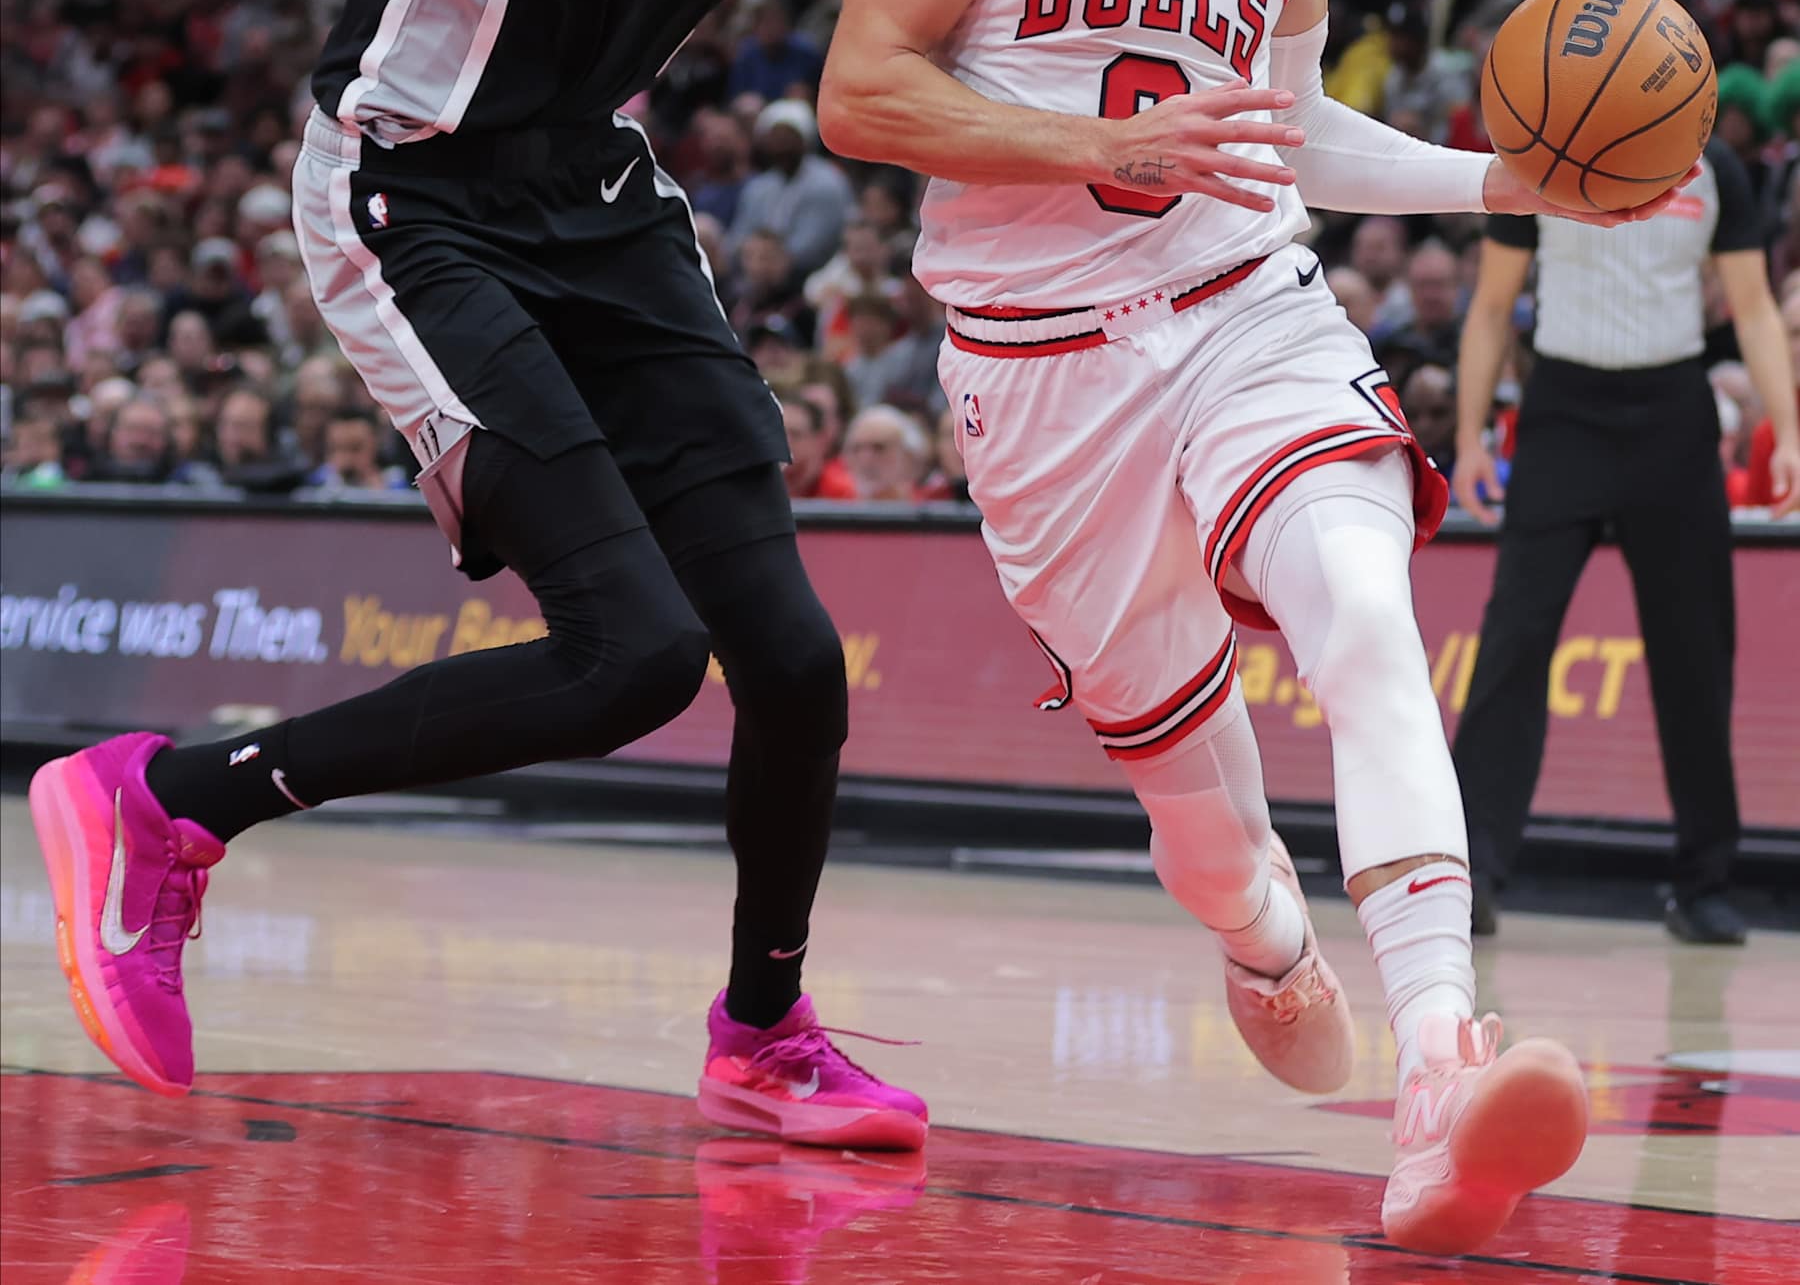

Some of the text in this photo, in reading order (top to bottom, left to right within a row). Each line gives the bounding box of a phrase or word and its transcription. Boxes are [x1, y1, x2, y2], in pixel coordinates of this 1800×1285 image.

[0, 582, 118, 655] ervice
[118, 602, 206, 657] was
[208, 587, 328, 663] Then.
[340, 594, 449, 667] Your
